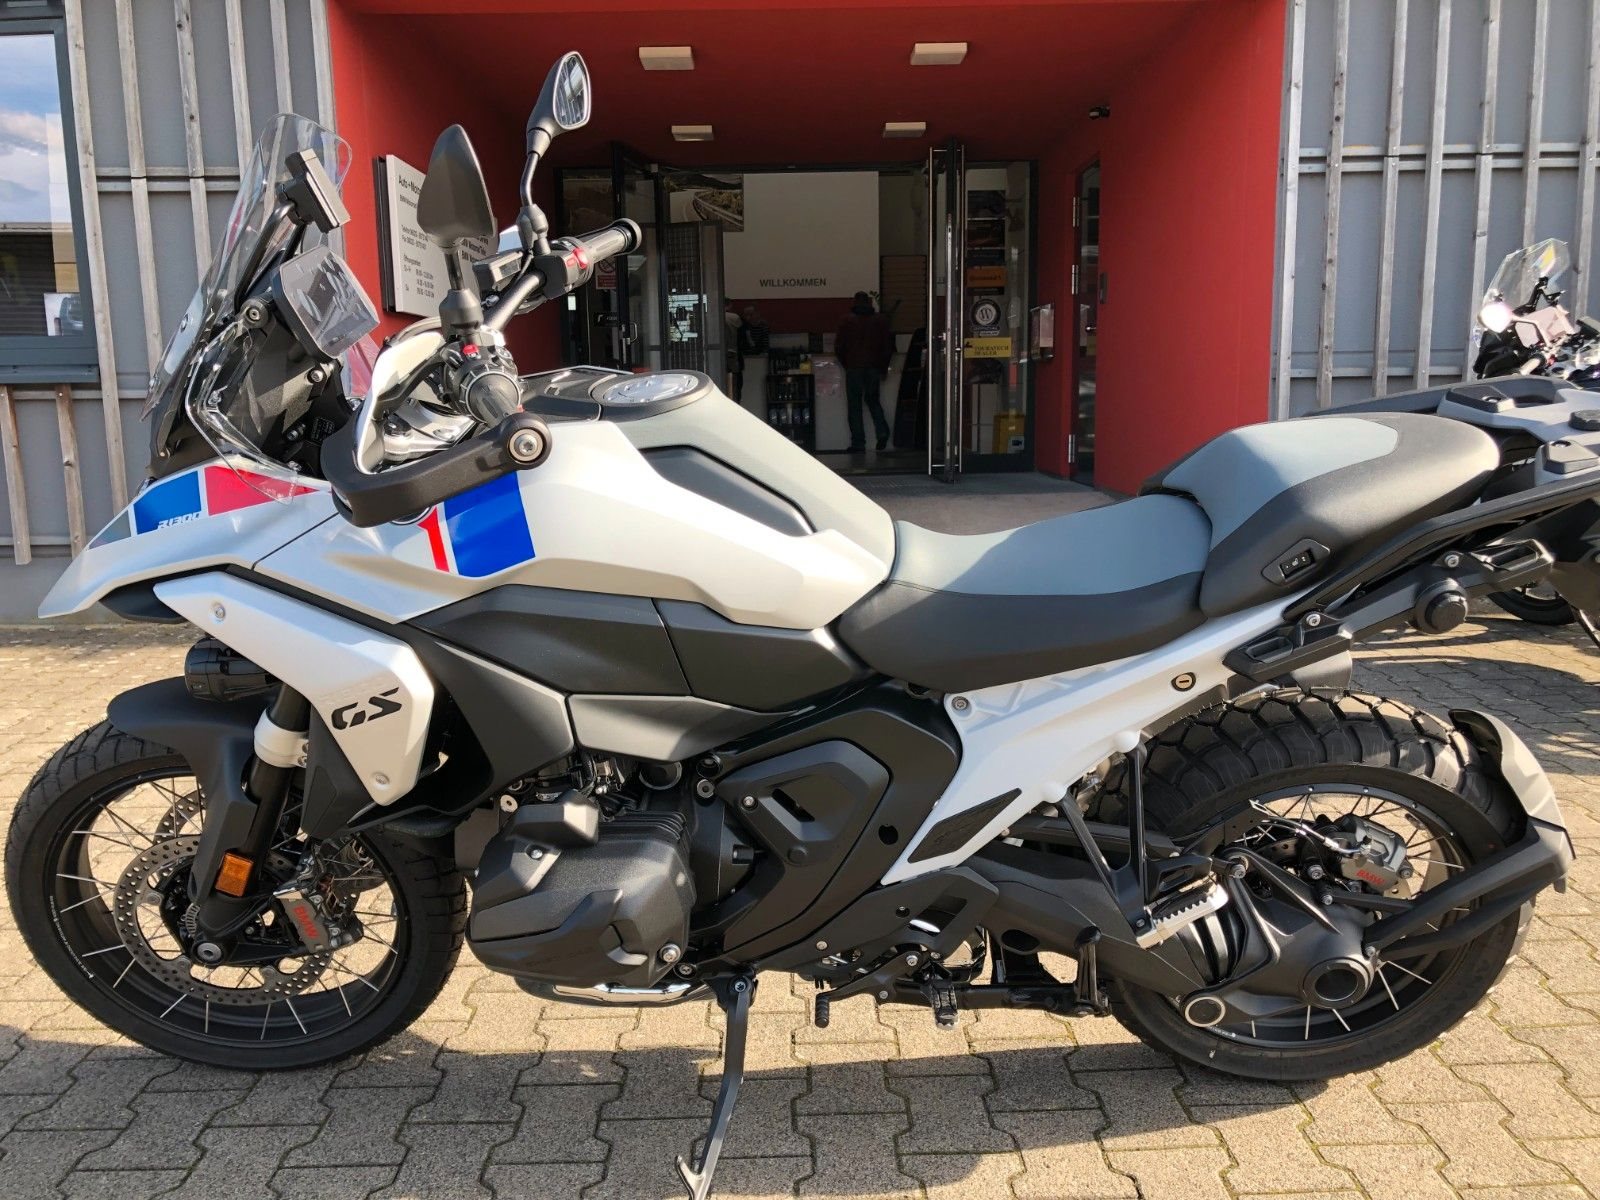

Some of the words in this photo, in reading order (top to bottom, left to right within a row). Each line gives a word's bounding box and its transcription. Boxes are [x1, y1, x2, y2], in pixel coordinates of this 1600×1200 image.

[759, 278, 827, 288] WILLKOMMEN
[331, 686, 403, 731] GS
[1355, 869, 1386, 886] BMW
[294, 905, 319, 938] BMW
